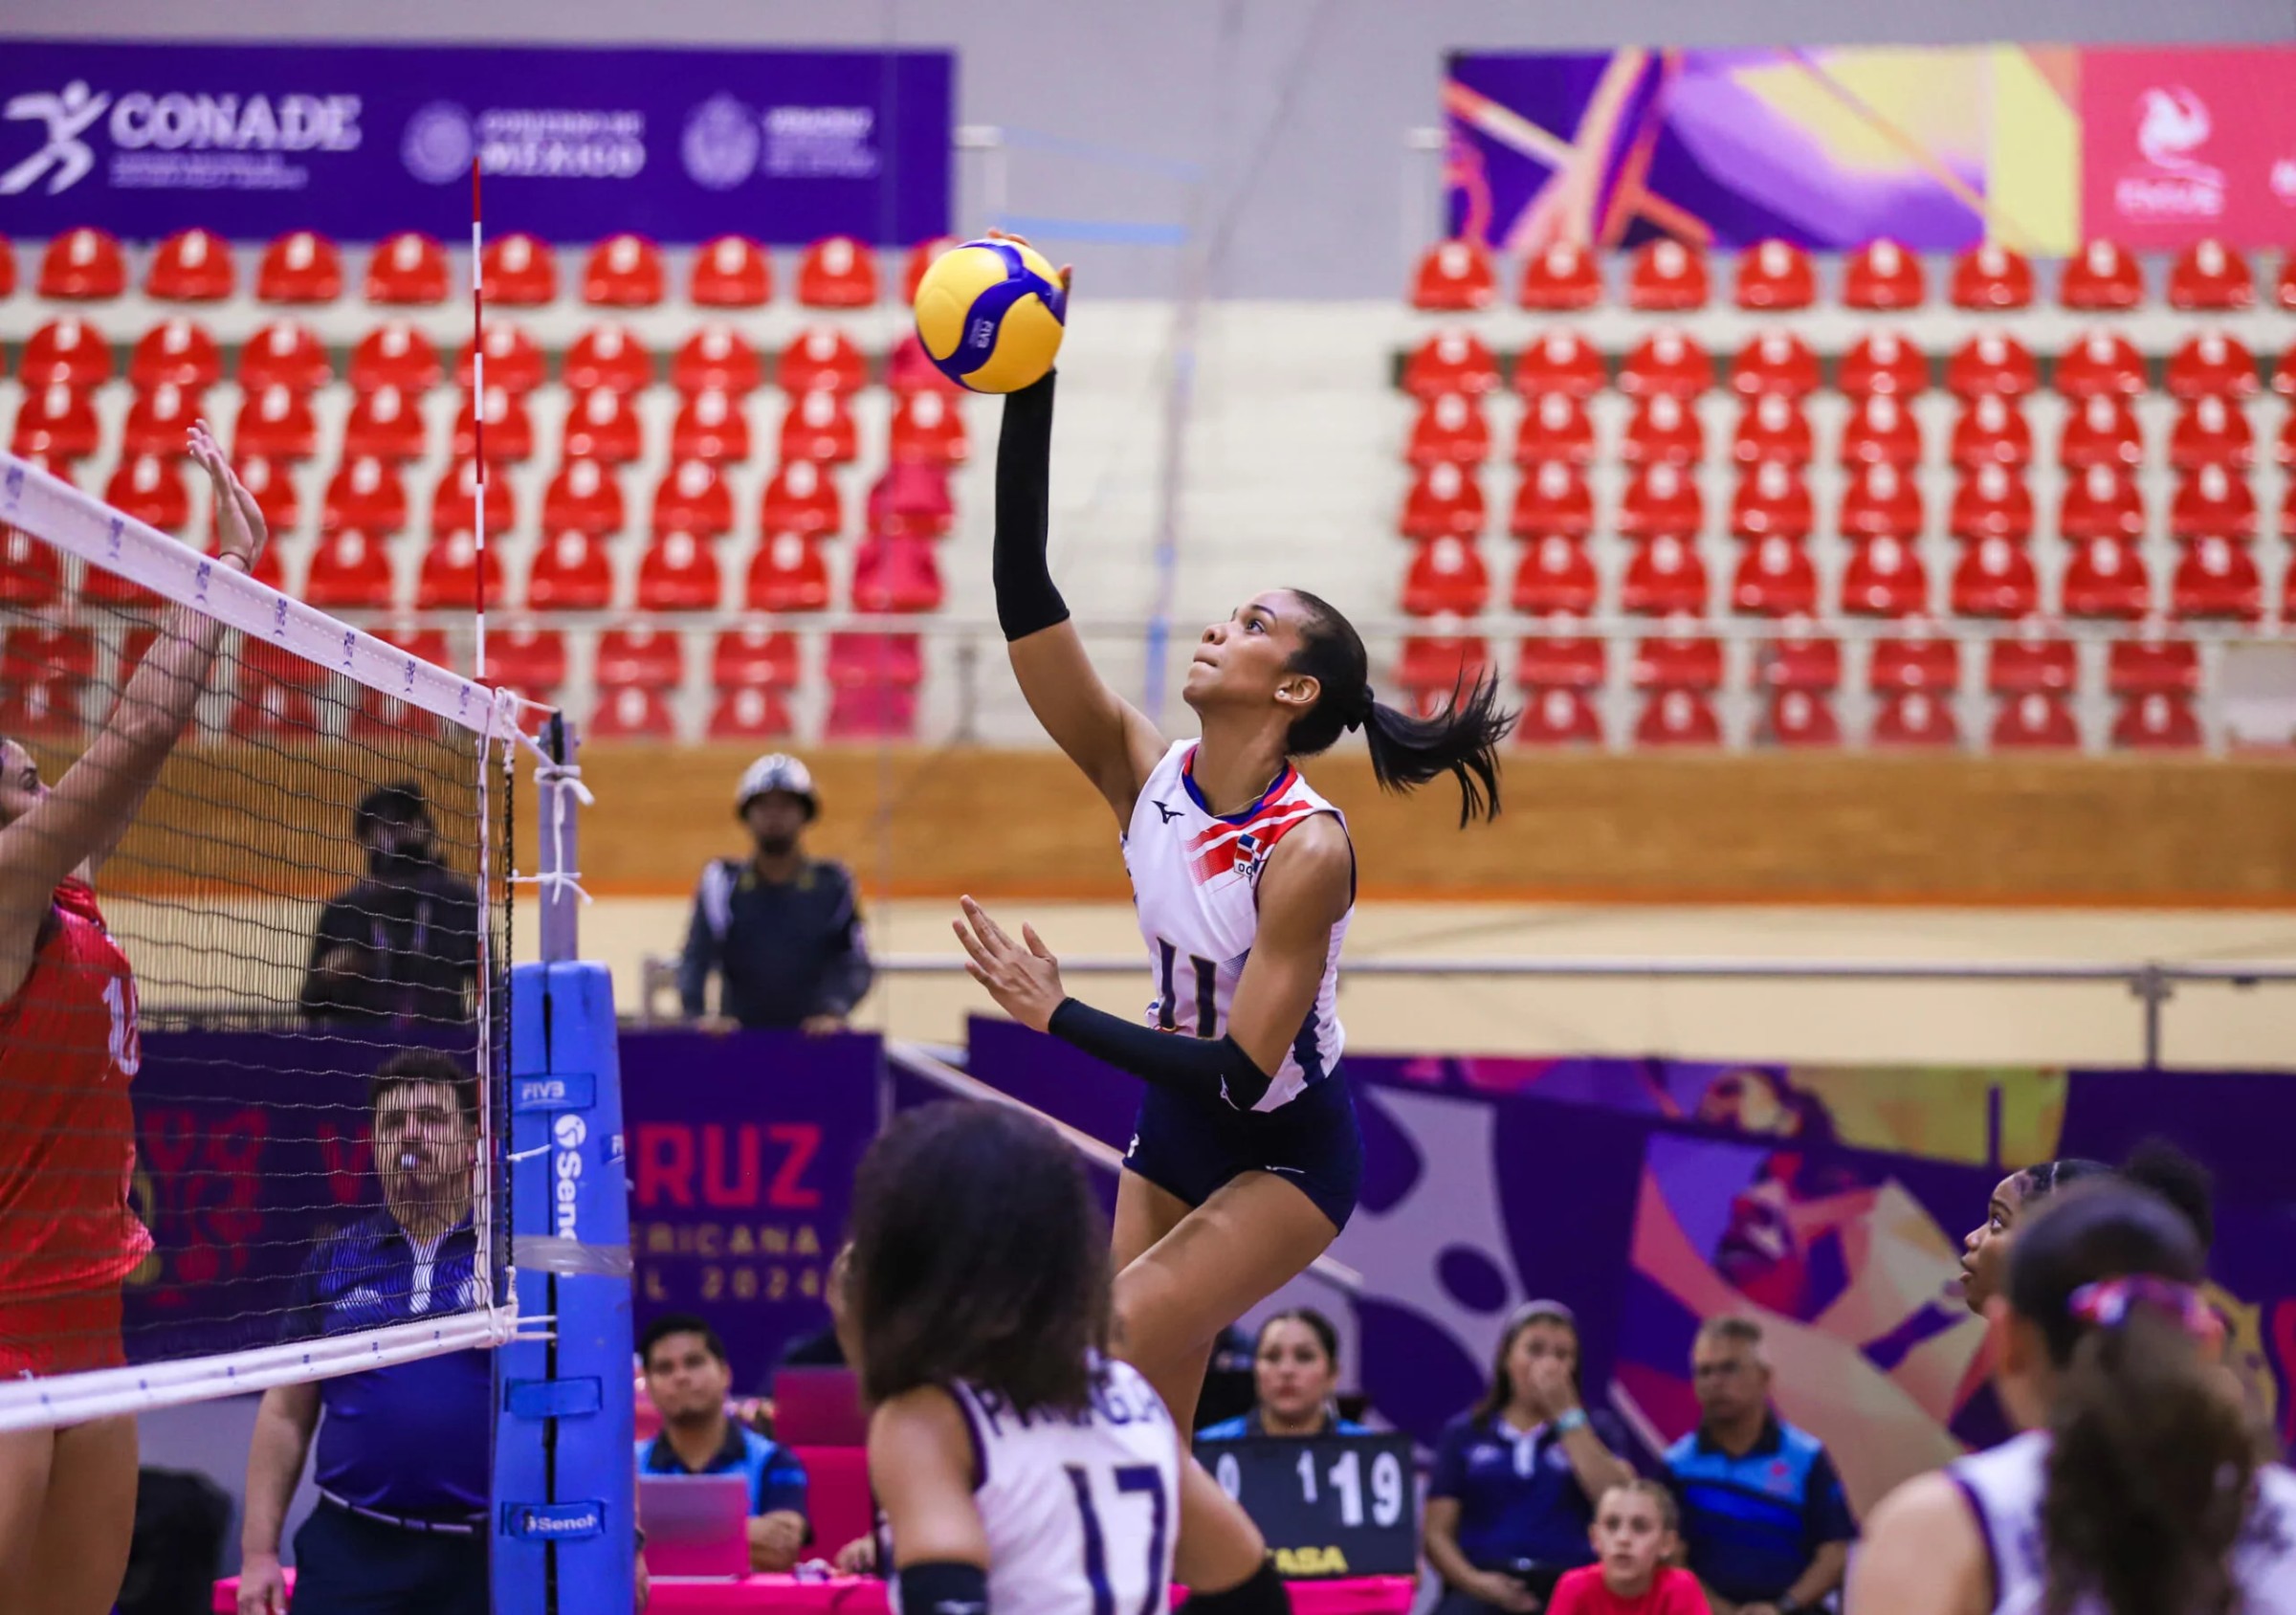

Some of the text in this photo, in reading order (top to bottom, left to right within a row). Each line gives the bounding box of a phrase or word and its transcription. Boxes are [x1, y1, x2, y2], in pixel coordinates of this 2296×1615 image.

[109, 93, 363, 150] CONADE
[1157, 937, 1217, 1040] 11
[521, 1080, 565, 1100] FIVB
[1296, 1449, 1318, 1503] 1
[1328, 1449, 1403, 1527] 19
[1065, 1463, 1168, 1615] 17
